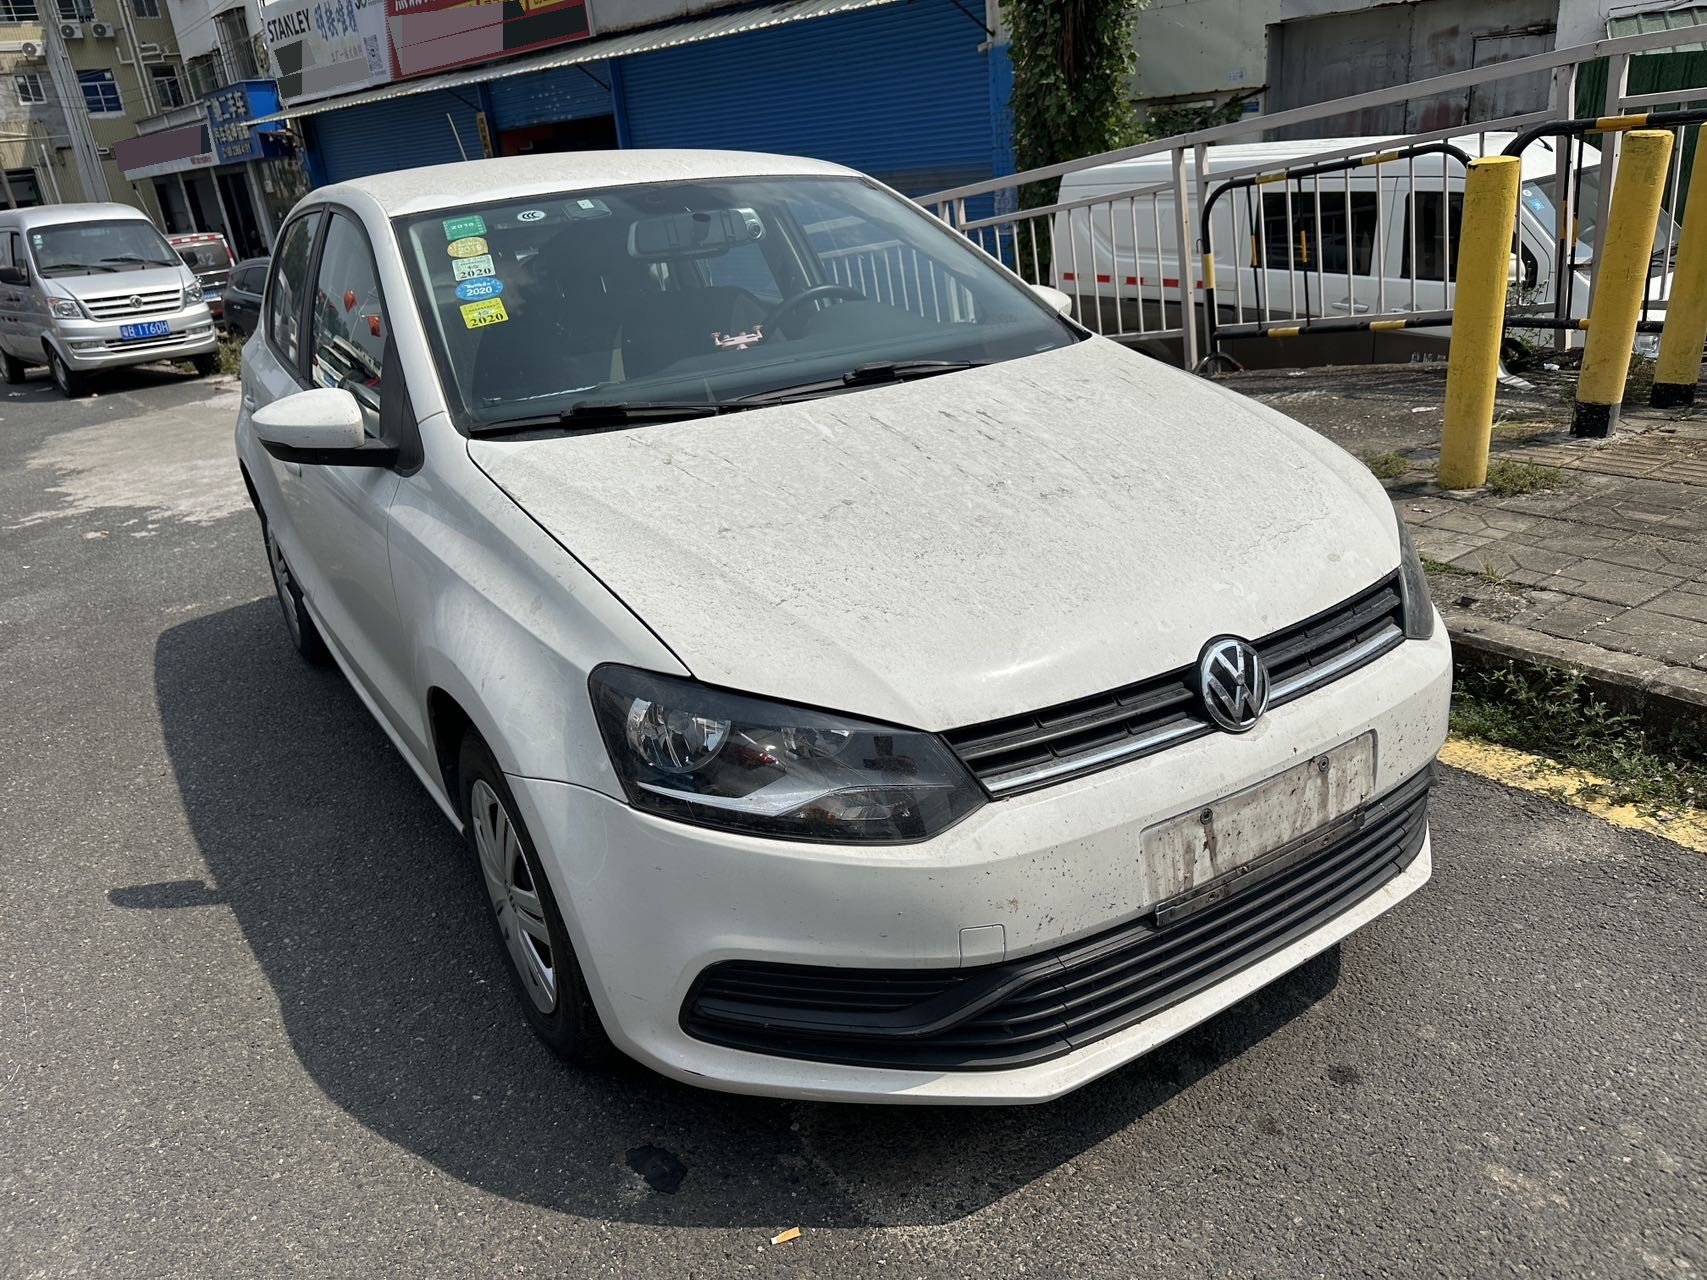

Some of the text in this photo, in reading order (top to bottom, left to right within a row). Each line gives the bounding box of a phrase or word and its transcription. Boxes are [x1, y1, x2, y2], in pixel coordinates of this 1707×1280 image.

[267, 8, 311, 42] STANLEY
[460, 268, 491, 279] 2020
[466, 287, 493, 296] 2020
[470, 313, 503, 327] 2020
